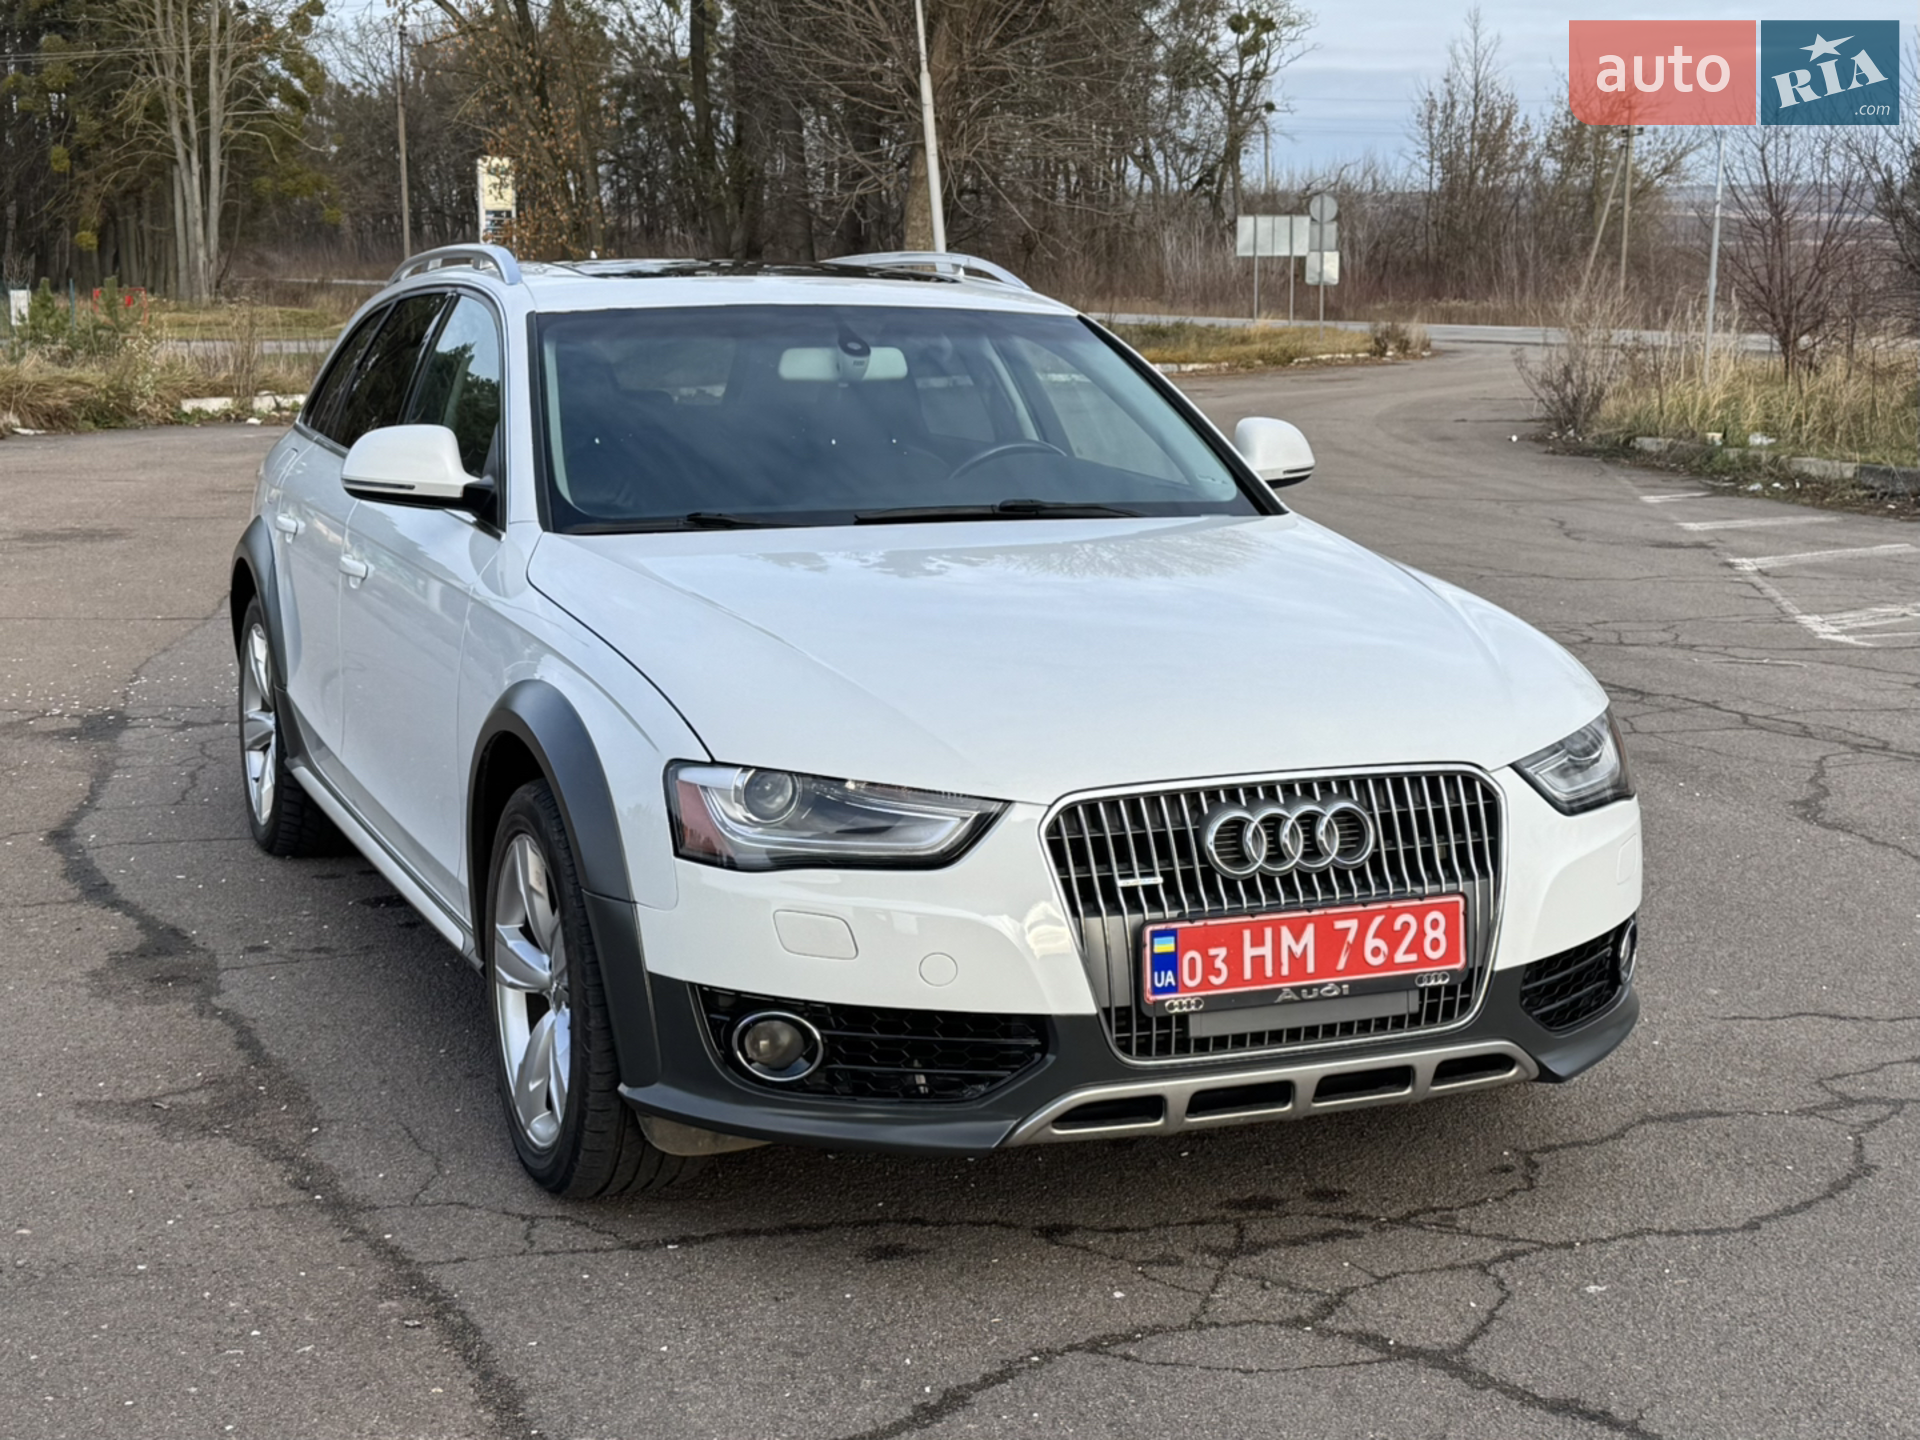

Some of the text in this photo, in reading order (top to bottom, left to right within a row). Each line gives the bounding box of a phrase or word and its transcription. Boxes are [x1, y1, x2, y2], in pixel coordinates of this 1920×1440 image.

[1182, 911, 1447, 987] 03 HM 7628
[1154, 970, 1176, 987] UA
